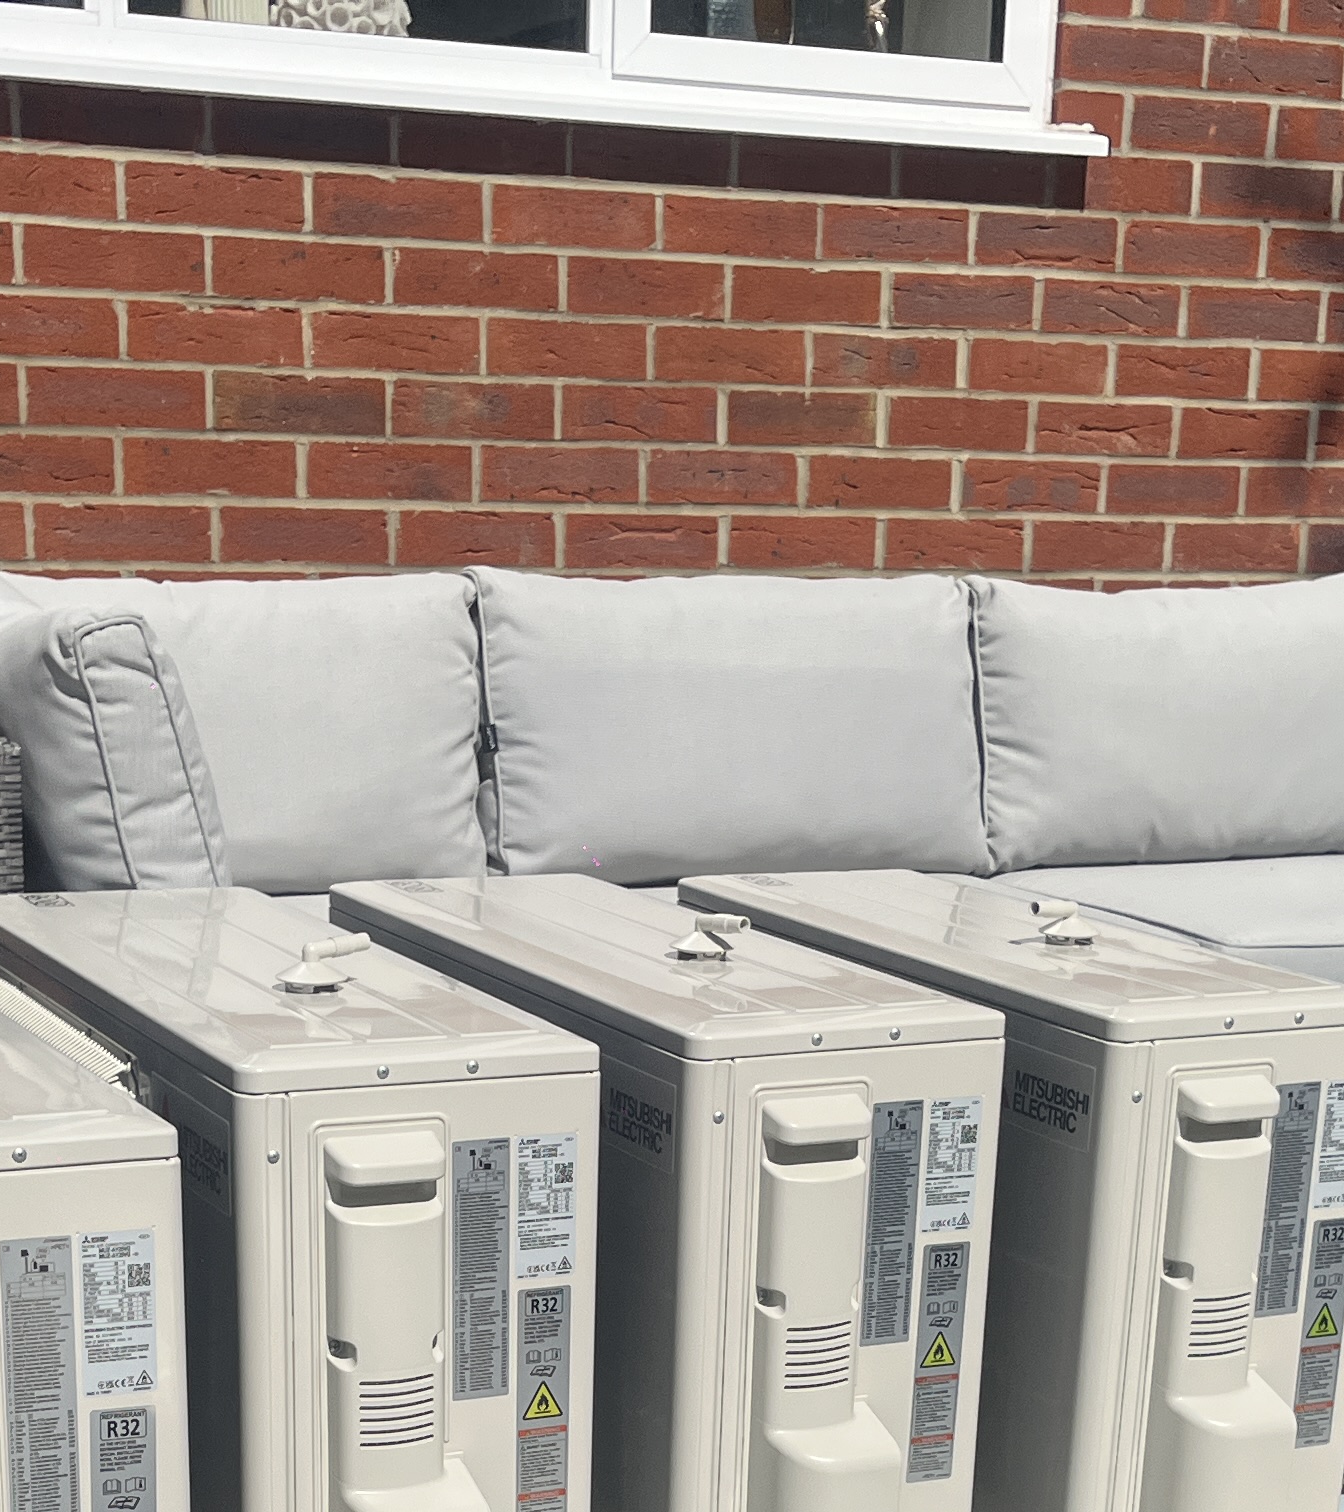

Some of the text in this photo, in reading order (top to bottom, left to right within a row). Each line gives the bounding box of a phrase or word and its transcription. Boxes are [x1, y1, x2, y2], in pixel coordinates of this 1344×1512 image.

[1015, 1070, 1090, 1115] MITSUBISHI
[610, 1088, 672, 1135] MITSUBISHI
[1013, 1092, 1077, 1133] ELECTRIC
[609, 1111, 663, 1154] ELECTRIC
[1322, 1226, 1344, 1242] R32
[934, 1252, 958, 1269] R32
[531, 1297, 558, 1314] R32
[107, 1418, 140, 1438] R32
